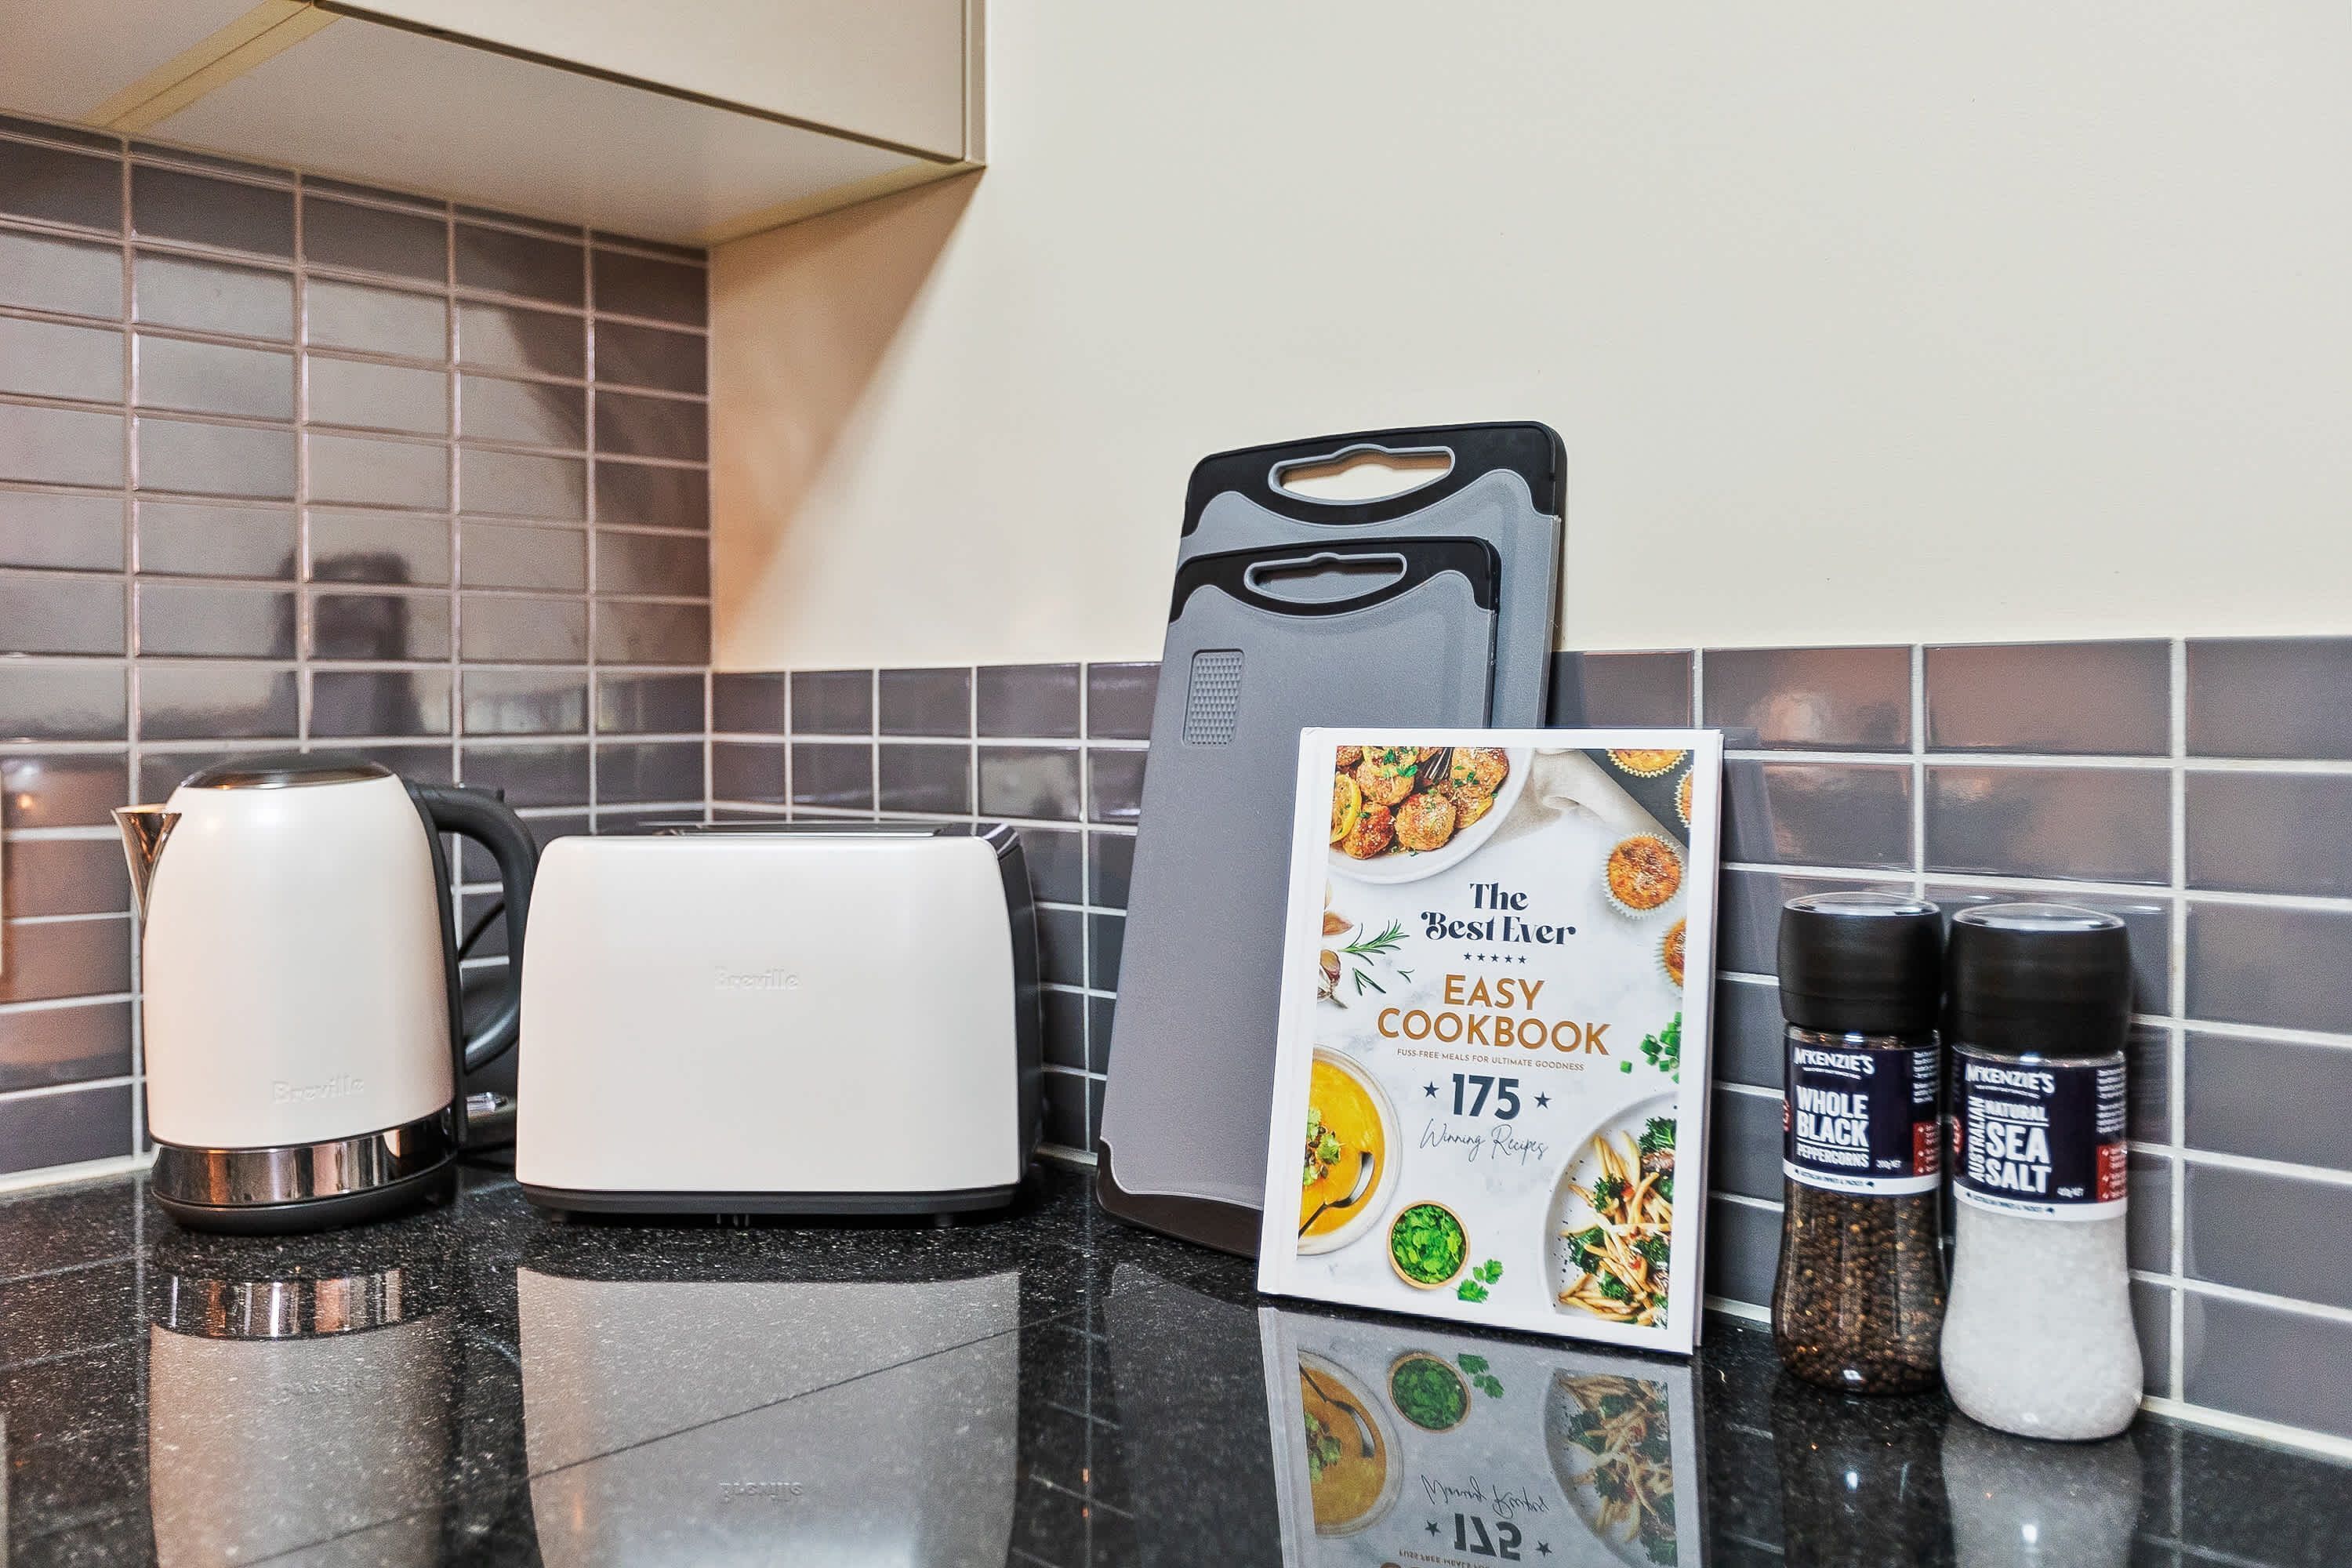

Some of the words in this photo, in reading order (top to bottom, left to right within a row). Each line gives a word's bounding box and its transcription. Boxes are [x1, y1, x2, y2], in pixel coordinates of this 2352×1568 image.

[1469, 882, 1529, 911] The
[1421, 910, 1495, 942] Best
[1501, 916, 1576, 946] Ever
[1443, 974, 1544, 1011] EASY
[1377, 1008, 1611, 1055] COOKBOOK
[1442, 1052, 1470, 1062] MEALS
[1472, 1054, 1490, 1063] FOR
[1491, 1058, 1533, 1067] ULTIMATE
[1535, 1060, 1585, 1072] GOODNESS
[1452, 1073, 1521, 1120] 175
[1796, 1085, 1869, 1119] WHOLE
[1985, 1100, 2049, 1122] NATURAL
[1419, 1119, 1486, 1161] Winning
[1491, 1124, 1549, 1165] Recipes
[1797, 1110, 1869, 1148] BLACK
[1968, 1095, 1986, 1183] AUSTRALIAN
[1985, 1122, 2051, 1163] SEA
[1797, 1142, 1870, 1168] PEPPERCORNS
[1984, 1157, 2053, 1194] SALT
